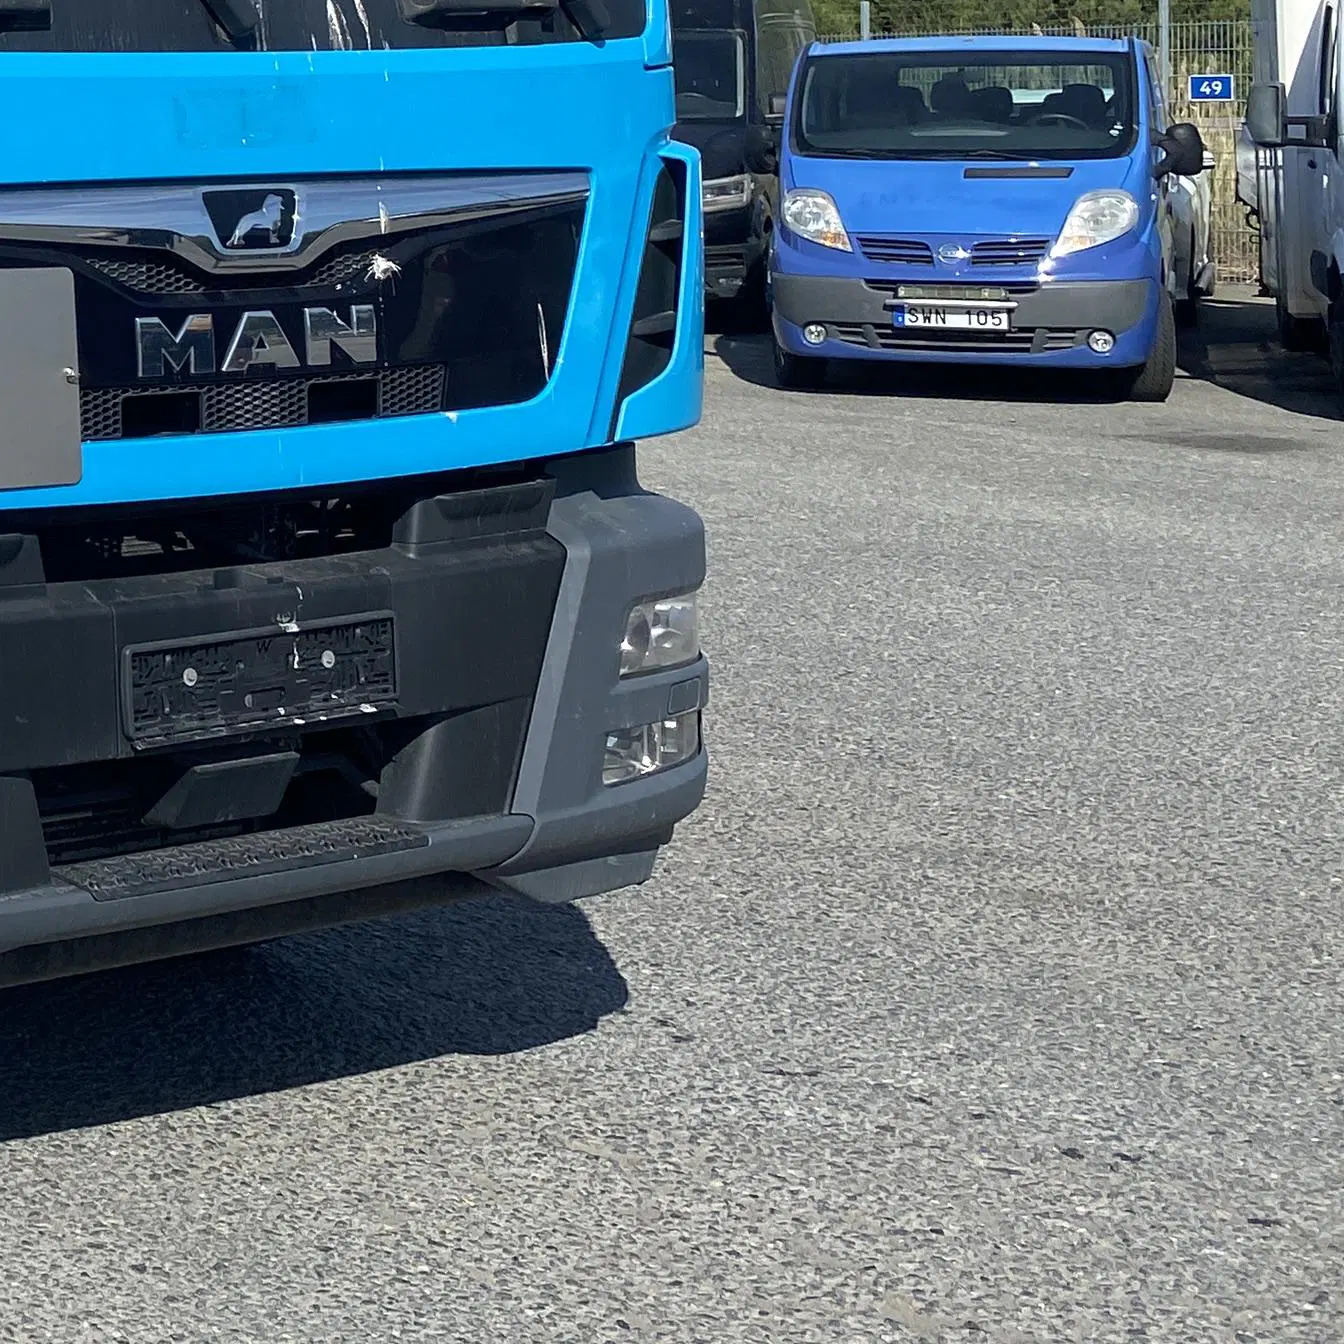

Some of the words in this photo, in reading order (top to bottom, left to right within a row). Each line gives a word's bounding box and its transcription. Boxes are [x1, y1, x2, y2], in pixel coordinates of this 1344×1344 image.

[1199, 80, 1223, 96] 49
[908, 307, 947, 325] SWN
[965, 309, 1002, 326] 105
[134, 303, 379, 379] MAN
